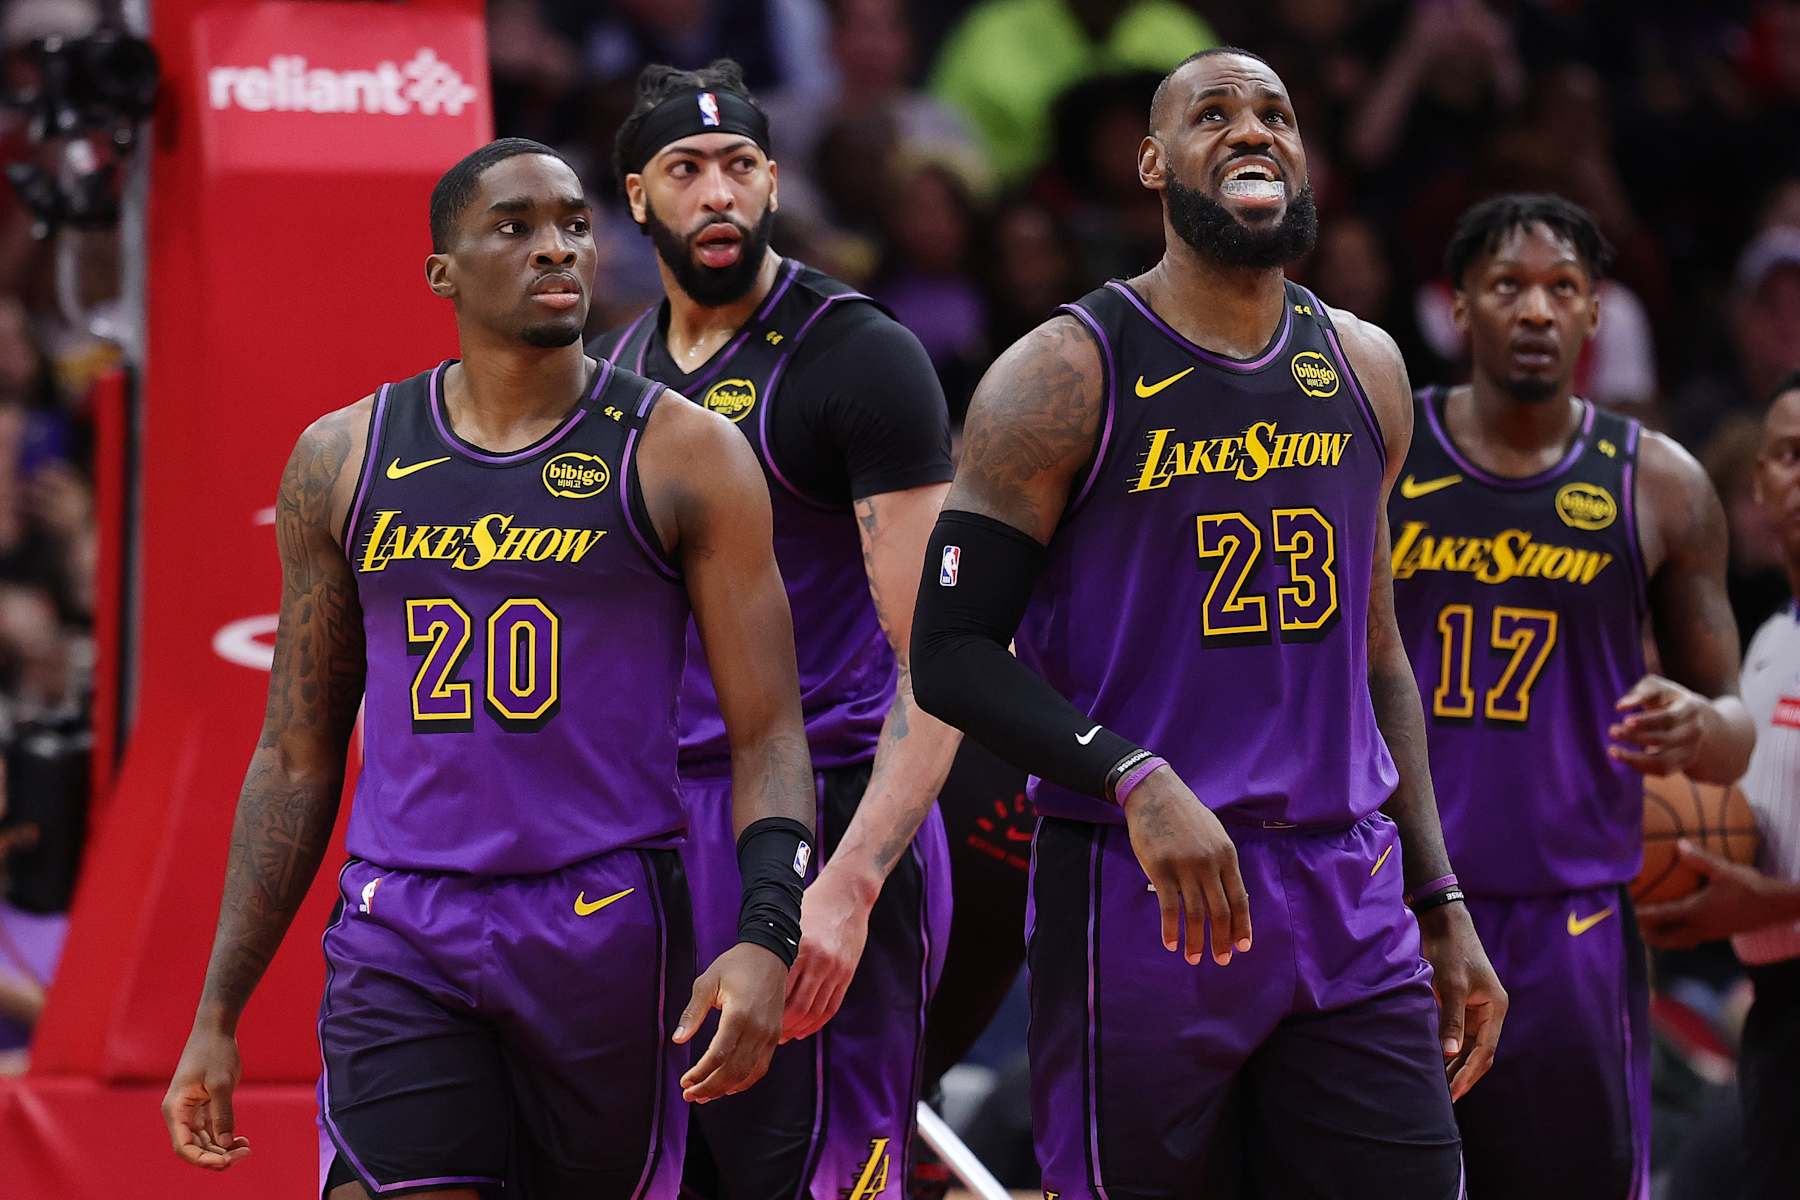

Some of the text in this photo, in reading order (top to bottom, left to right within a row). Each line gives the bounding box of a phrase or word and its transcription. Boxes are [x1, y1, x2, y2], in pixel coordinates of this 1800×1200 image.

[208, 54, 411, 115] reliant
[1295, 362, 1335, 385] bibigo
[603, 405, 624, 422] 44
[709, 390, 753, 411] bibigo
[549, 463, 606, 486] bibigo
[1196, 507, 1338, 638] 23
[405, 598, 559, 722] 20
[1433, 603, 1559, 722] 17
